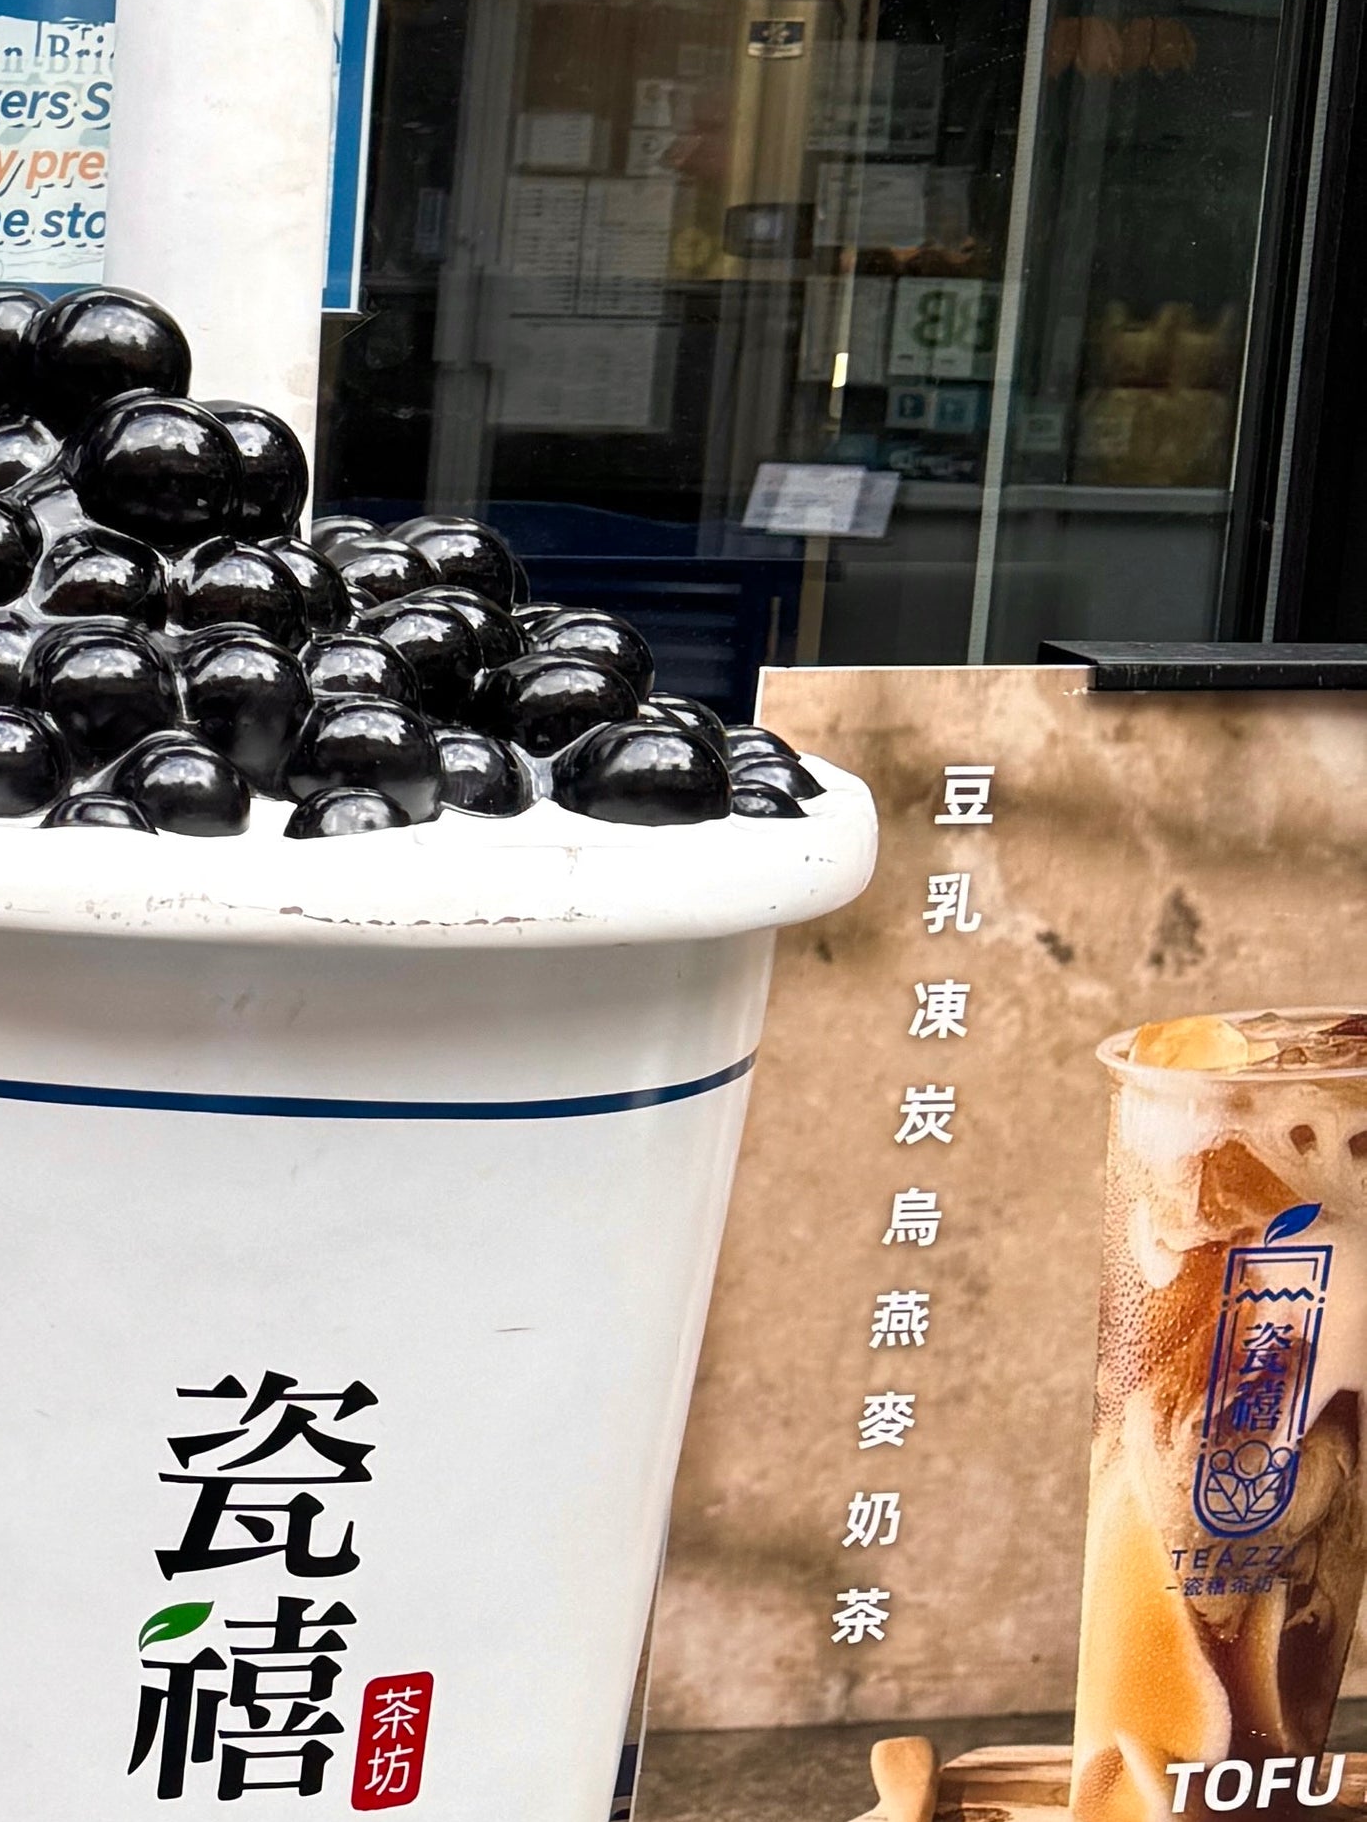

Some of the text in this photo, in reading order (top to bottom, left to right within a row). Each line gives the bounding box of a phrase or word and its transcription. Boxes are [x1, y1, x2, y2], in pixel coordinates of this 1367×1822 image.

[47, 34, 115, 75] Bri
[81, 81, 113, 121] S
[25, 150, 106, 189] pre
[41, 203, 106, 239] sto
[829, 764, 997, 1645] 豆乳凍炭烏燕麥奶茶
[127, 1370, 379, 1801] 瓷禧
[362, 1686, 421, 1797] 茶坊
[1165, 1754, 1346, 1813] TOFU
